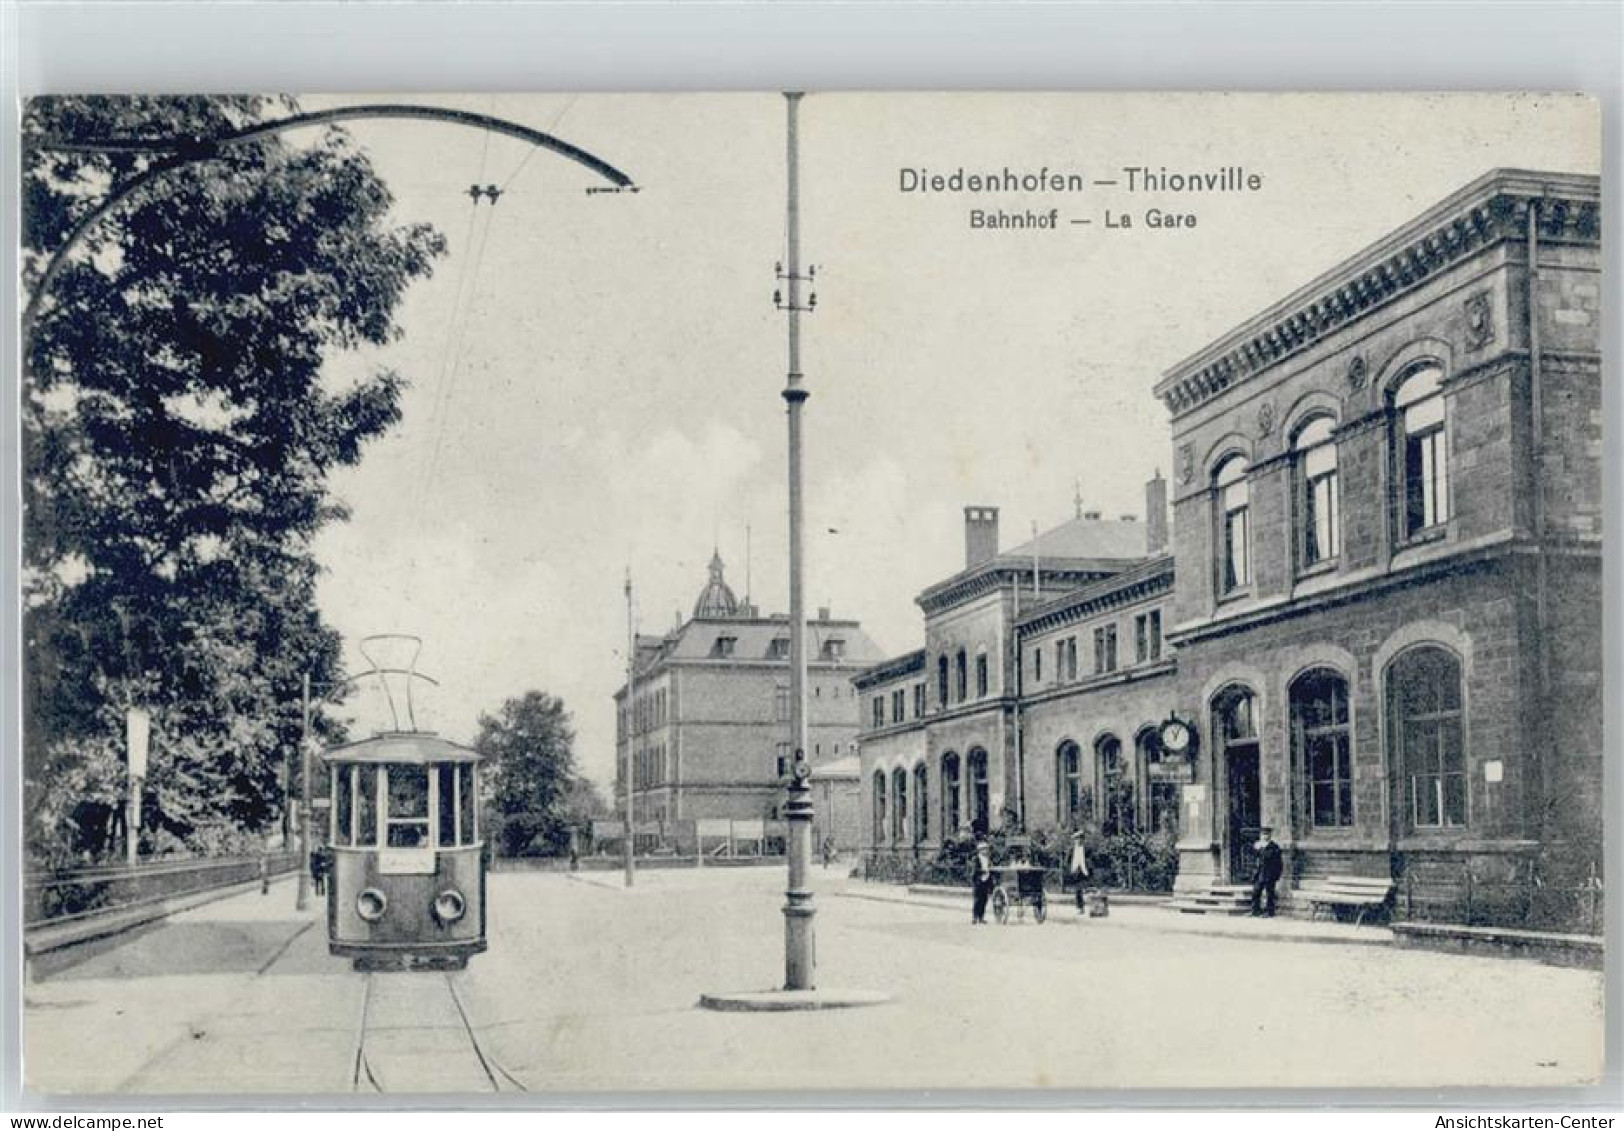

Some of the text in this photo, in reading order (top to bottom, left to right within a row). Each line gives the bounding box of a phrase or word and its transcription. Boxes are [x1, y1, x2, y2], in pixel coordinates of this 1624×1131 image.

[900, 167, 1082, 192] Diedenhofen
[1124, 166, 1262, 192] Thionville
[970, 209, 1058, 229] Bahnhof
[1105, 211, 1131, 229] La
[1145, 208, 1197, 229] Gare
